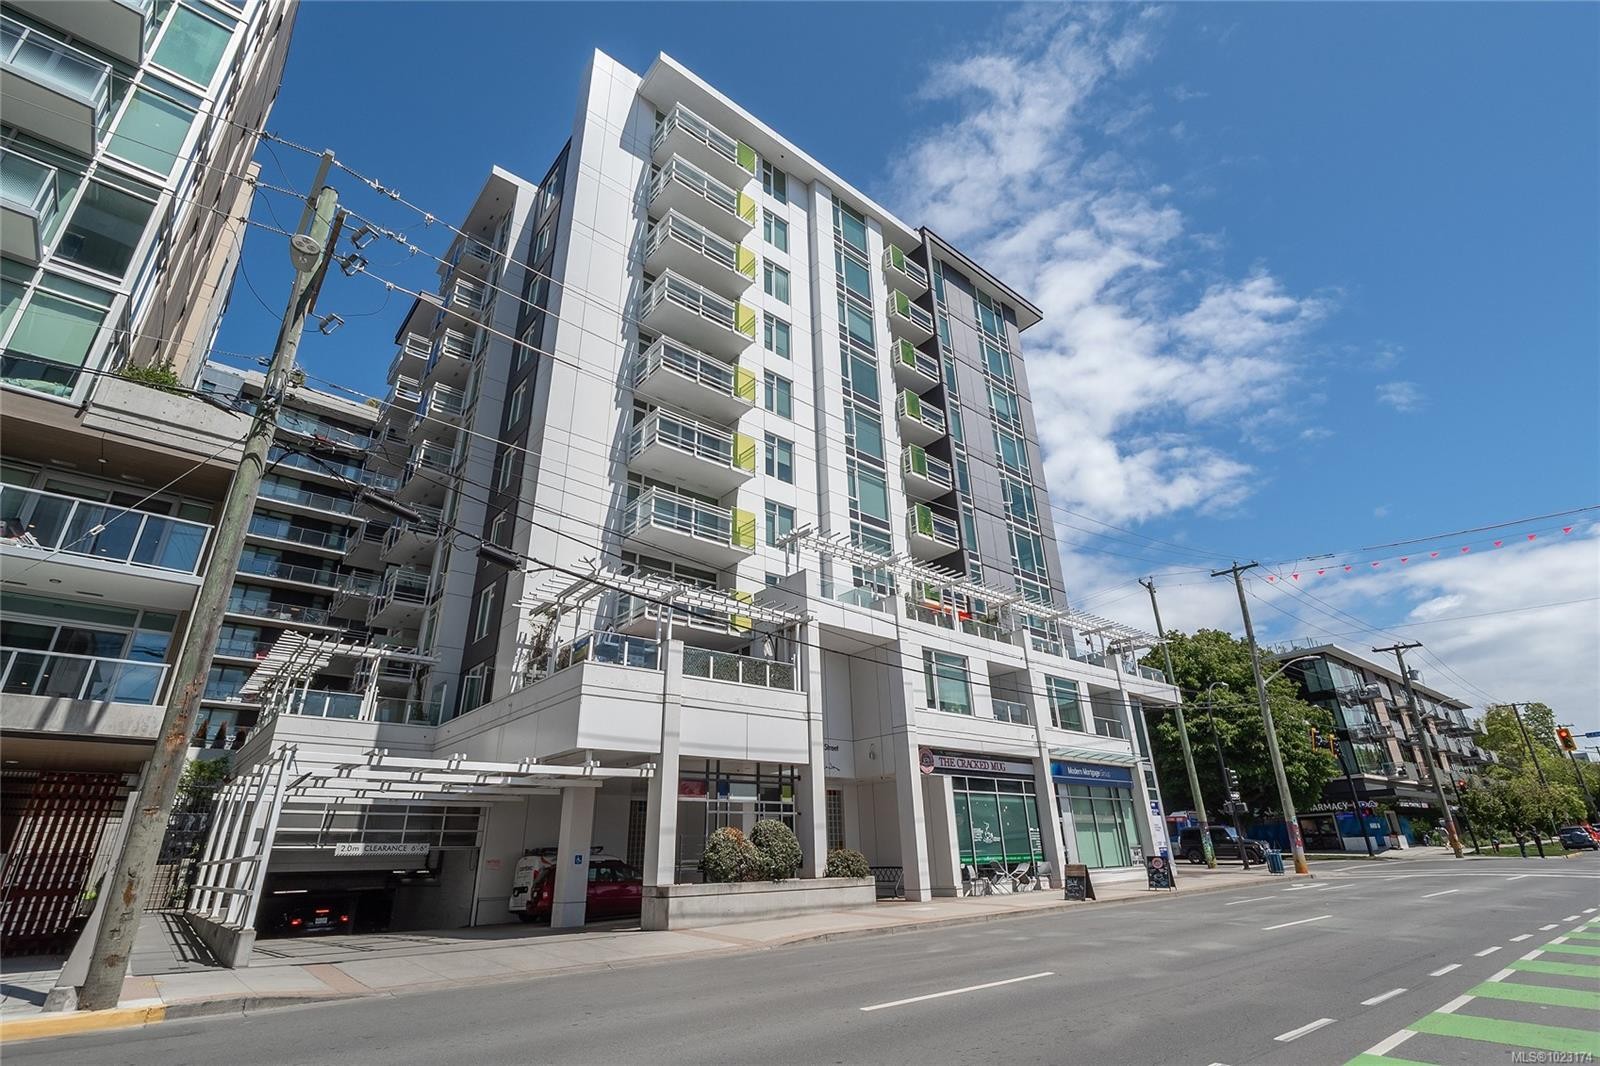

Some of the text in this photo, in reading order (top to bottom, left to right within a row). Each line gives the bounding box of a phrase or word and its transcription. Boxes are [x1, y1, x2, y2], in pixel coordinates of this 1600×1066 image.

[824, 743, 839, 751] Street
[938, 757, 1006, 771] THE CRACKED MUG
[1067, 766, 1082, 775] Modern
[1082, 768, 1100, 777] Mortgage
[1309, 801, 1348, 811] ARMACY
